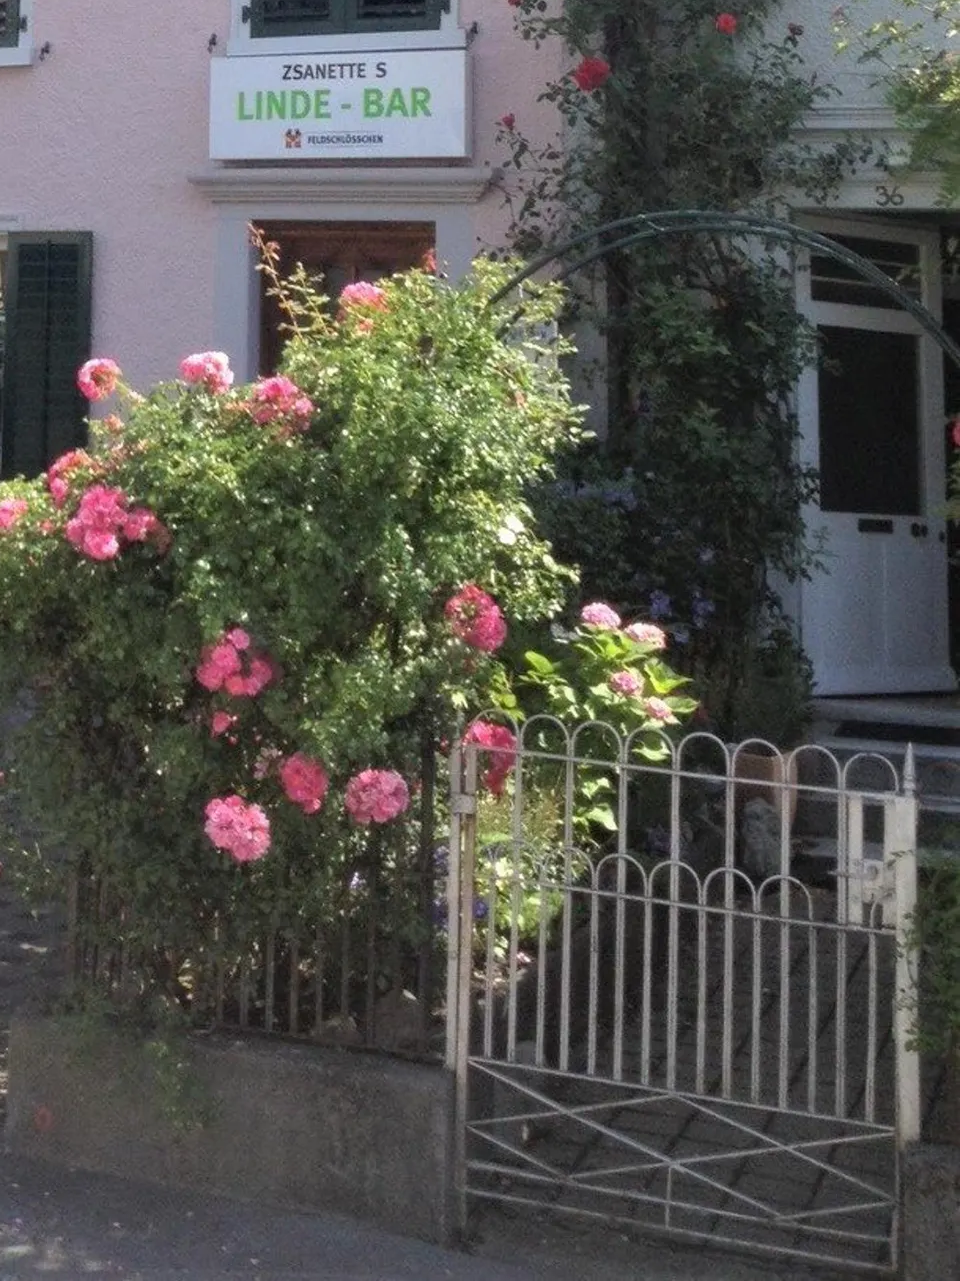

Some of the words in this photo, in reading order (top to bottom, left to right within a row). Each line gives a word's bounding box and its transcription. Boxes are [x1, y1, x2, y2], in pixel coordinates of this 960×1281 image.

[282, 62, 367, 81] ZSANETTE
[375, 61, 388, 79] S
[237, 88, 332, 121] LINDE
[362, 85, 433, 119] BAR
[307, 133, 384, 145] FELDSCHLÖSSCHEN
[875, 184, 905, 207] 36
